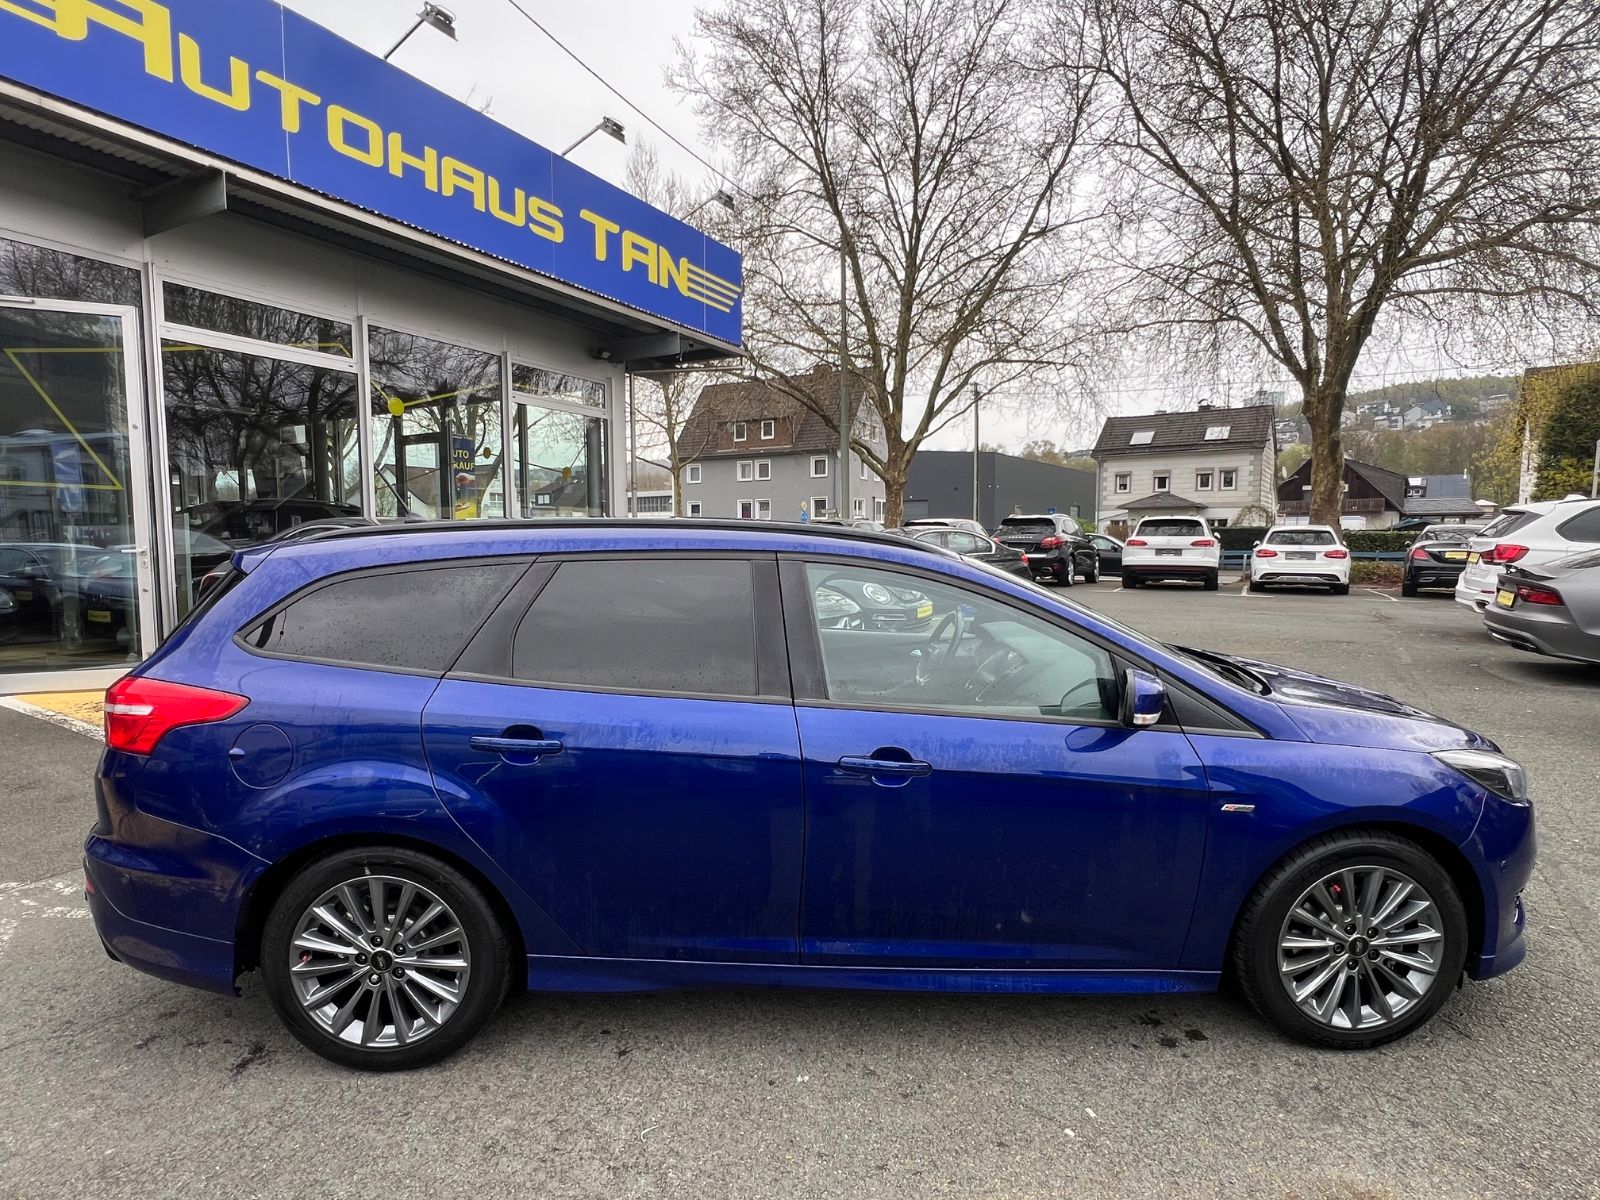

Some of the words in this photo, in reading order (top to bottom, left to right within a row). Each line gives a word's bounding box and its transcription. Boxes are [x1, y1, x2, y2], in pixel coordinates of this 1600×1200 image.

[579, 209, 689, 297] TAN
[453, 450, 469, 459] UTO
[453, 461, 475, 470] KAUF
